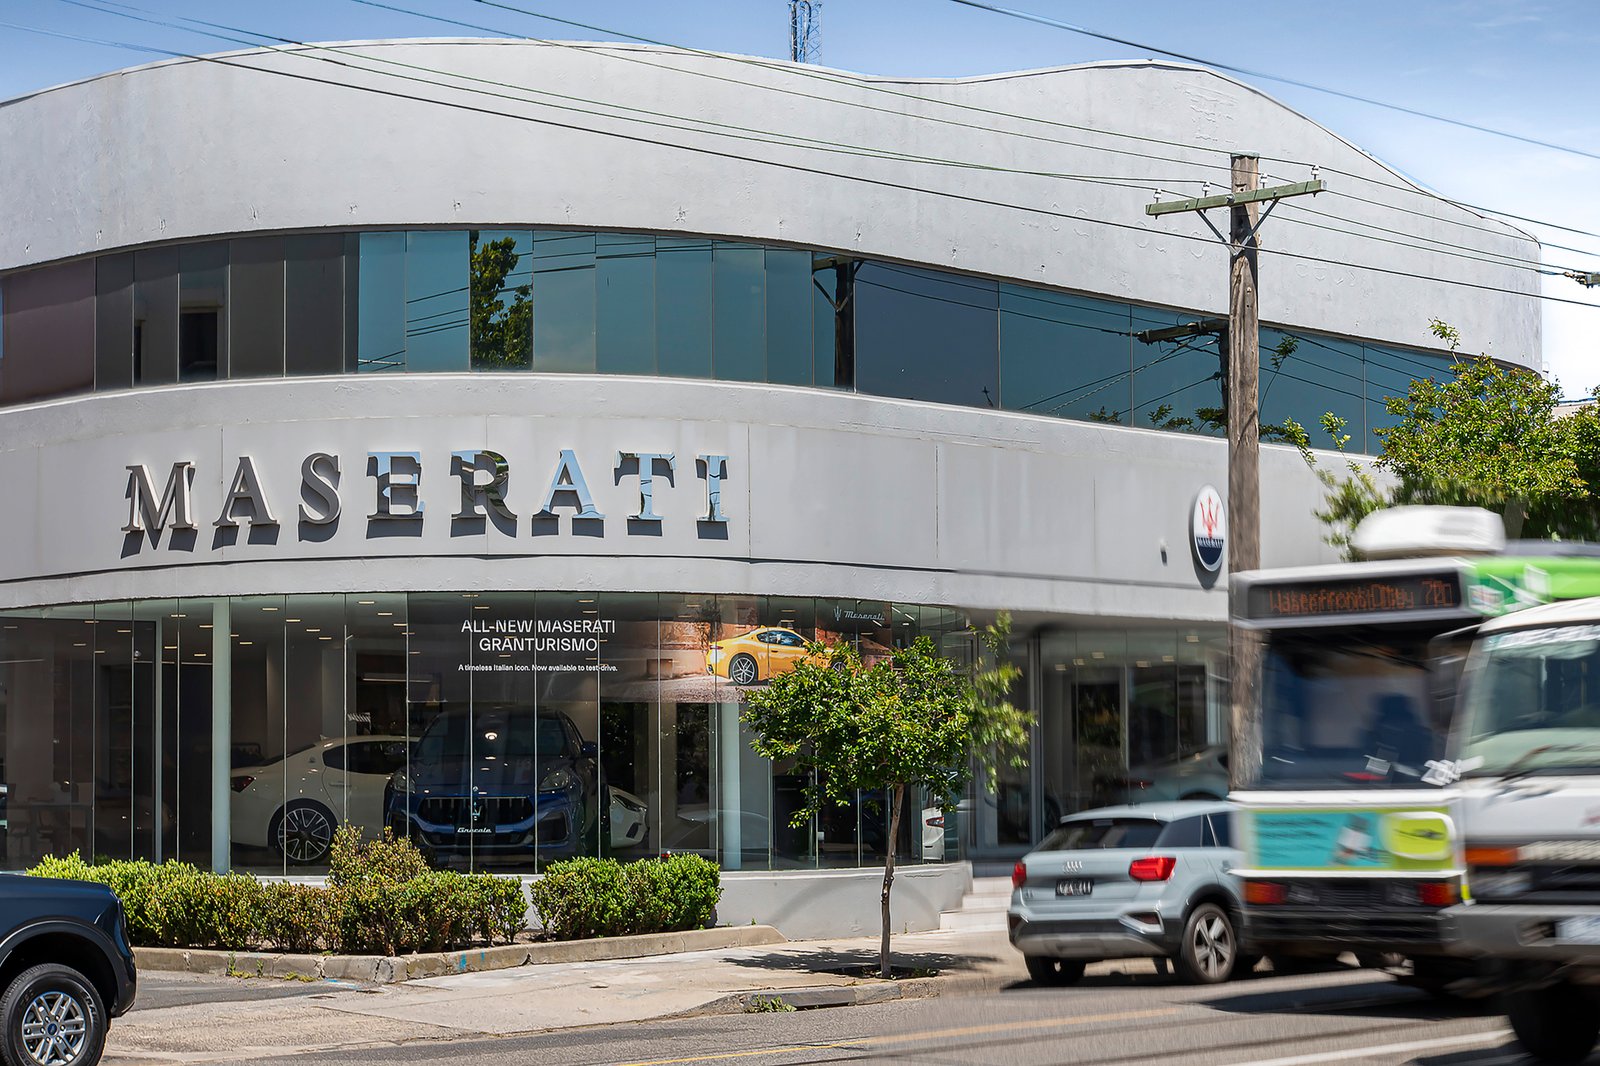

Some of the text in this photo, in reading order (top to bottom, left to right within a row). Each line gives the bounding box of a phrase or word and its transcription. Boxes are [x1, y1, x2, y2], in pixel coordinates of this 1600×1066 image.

[121, 449, 731, 532] MASERATI
[461, 619, 616, 634] ALL-NEW MASERATI
[479, 637, 598, 651] GRANTURISMO
[548, 664, 577, 672] available
